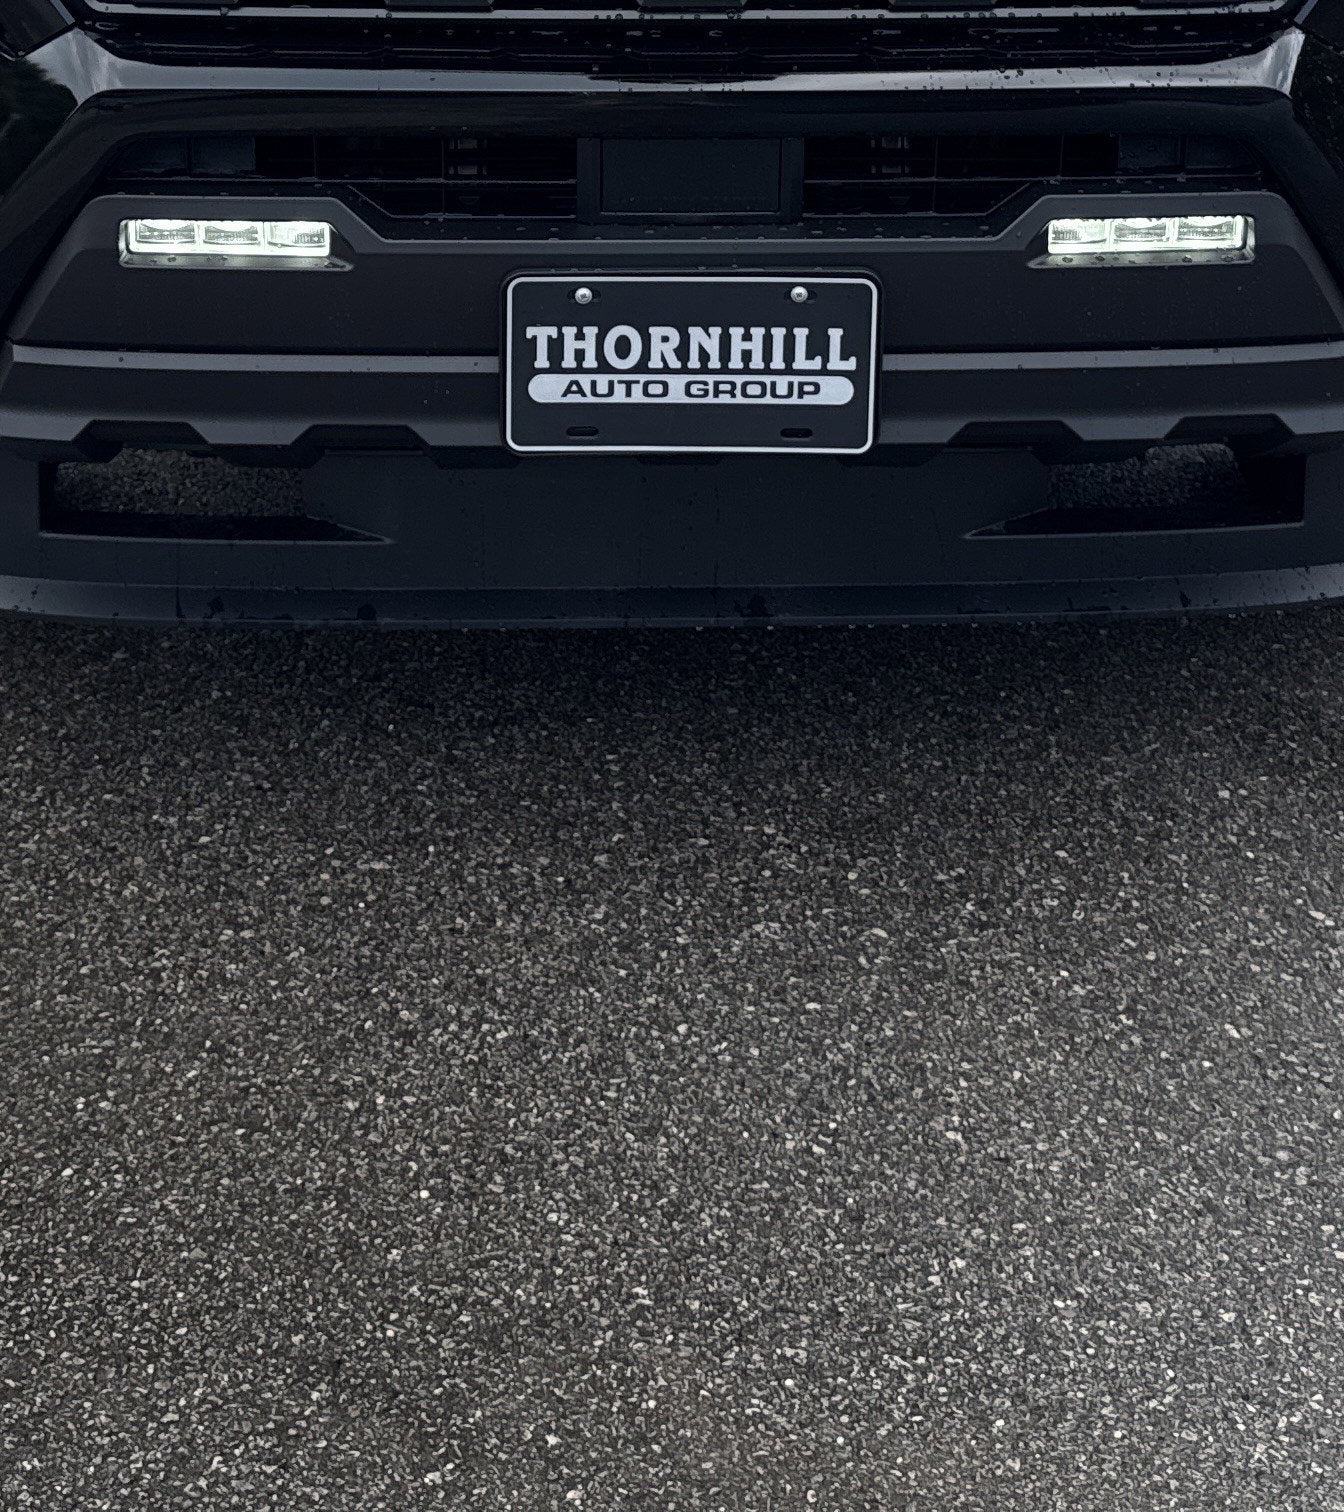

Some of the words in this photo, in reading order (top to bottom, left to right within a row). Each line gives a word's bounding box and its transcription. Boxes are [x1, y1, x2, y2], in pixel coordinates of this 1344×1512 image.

[526, 325, 856, 371] THORNHILL
[561, 379, 669, 399] AUTO
[684, 380, 821, 400] GROUP
